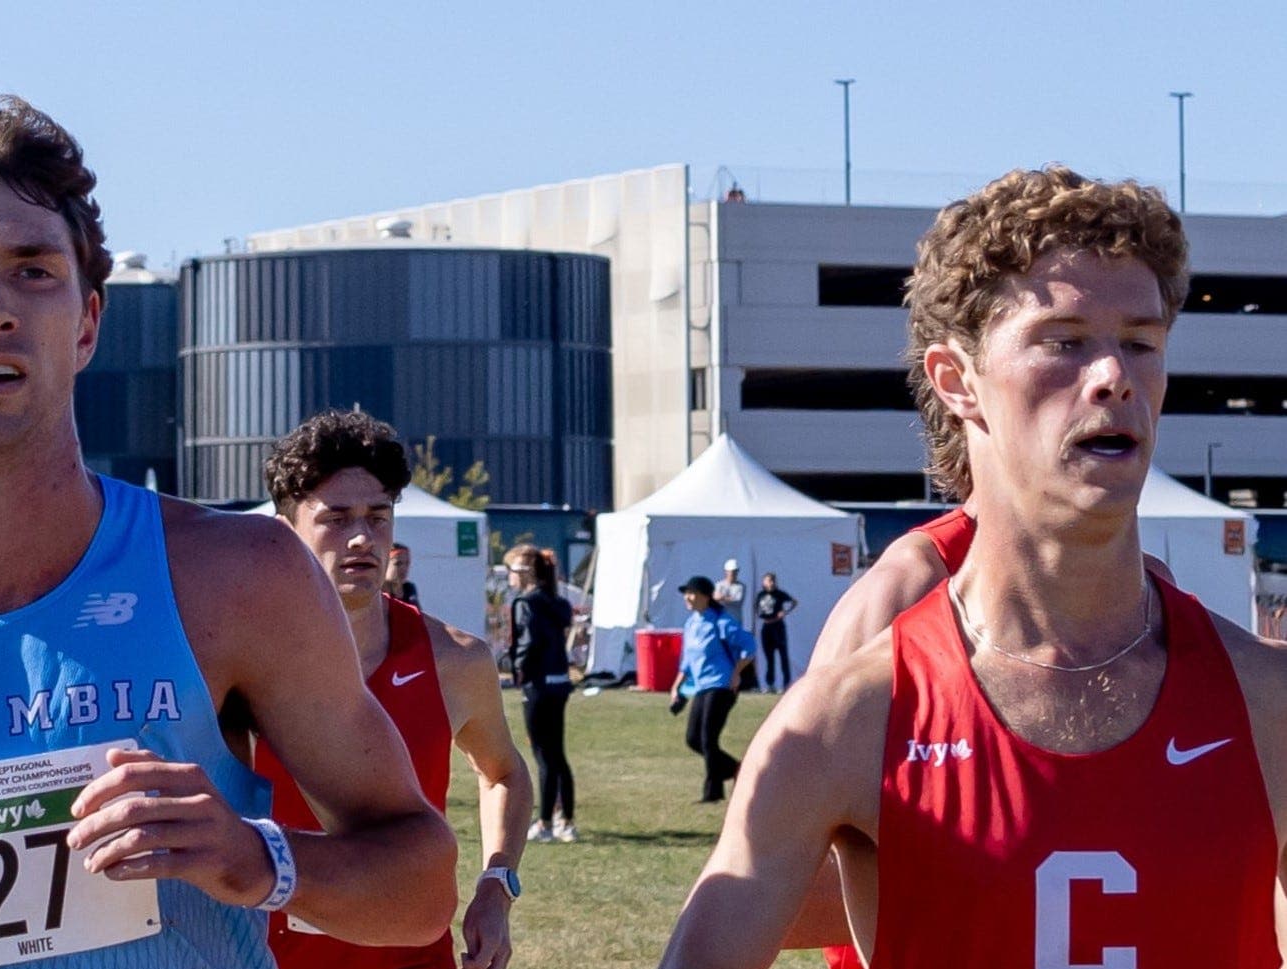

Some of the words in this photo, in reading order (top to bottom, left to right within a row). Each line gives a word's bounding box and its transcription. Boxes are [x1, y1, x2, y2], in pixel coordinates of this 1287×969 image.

[906, 739, 949, 767] Ivy
[11, 762, 92, 784] CHAMPIONSHIPS
[2, 785, 27, 795] CROSS
[28, 778, 64, 791] COUNTRY
[64, 774, 94, 784] COURSE
[17, 936, 54, 956] WHITE
